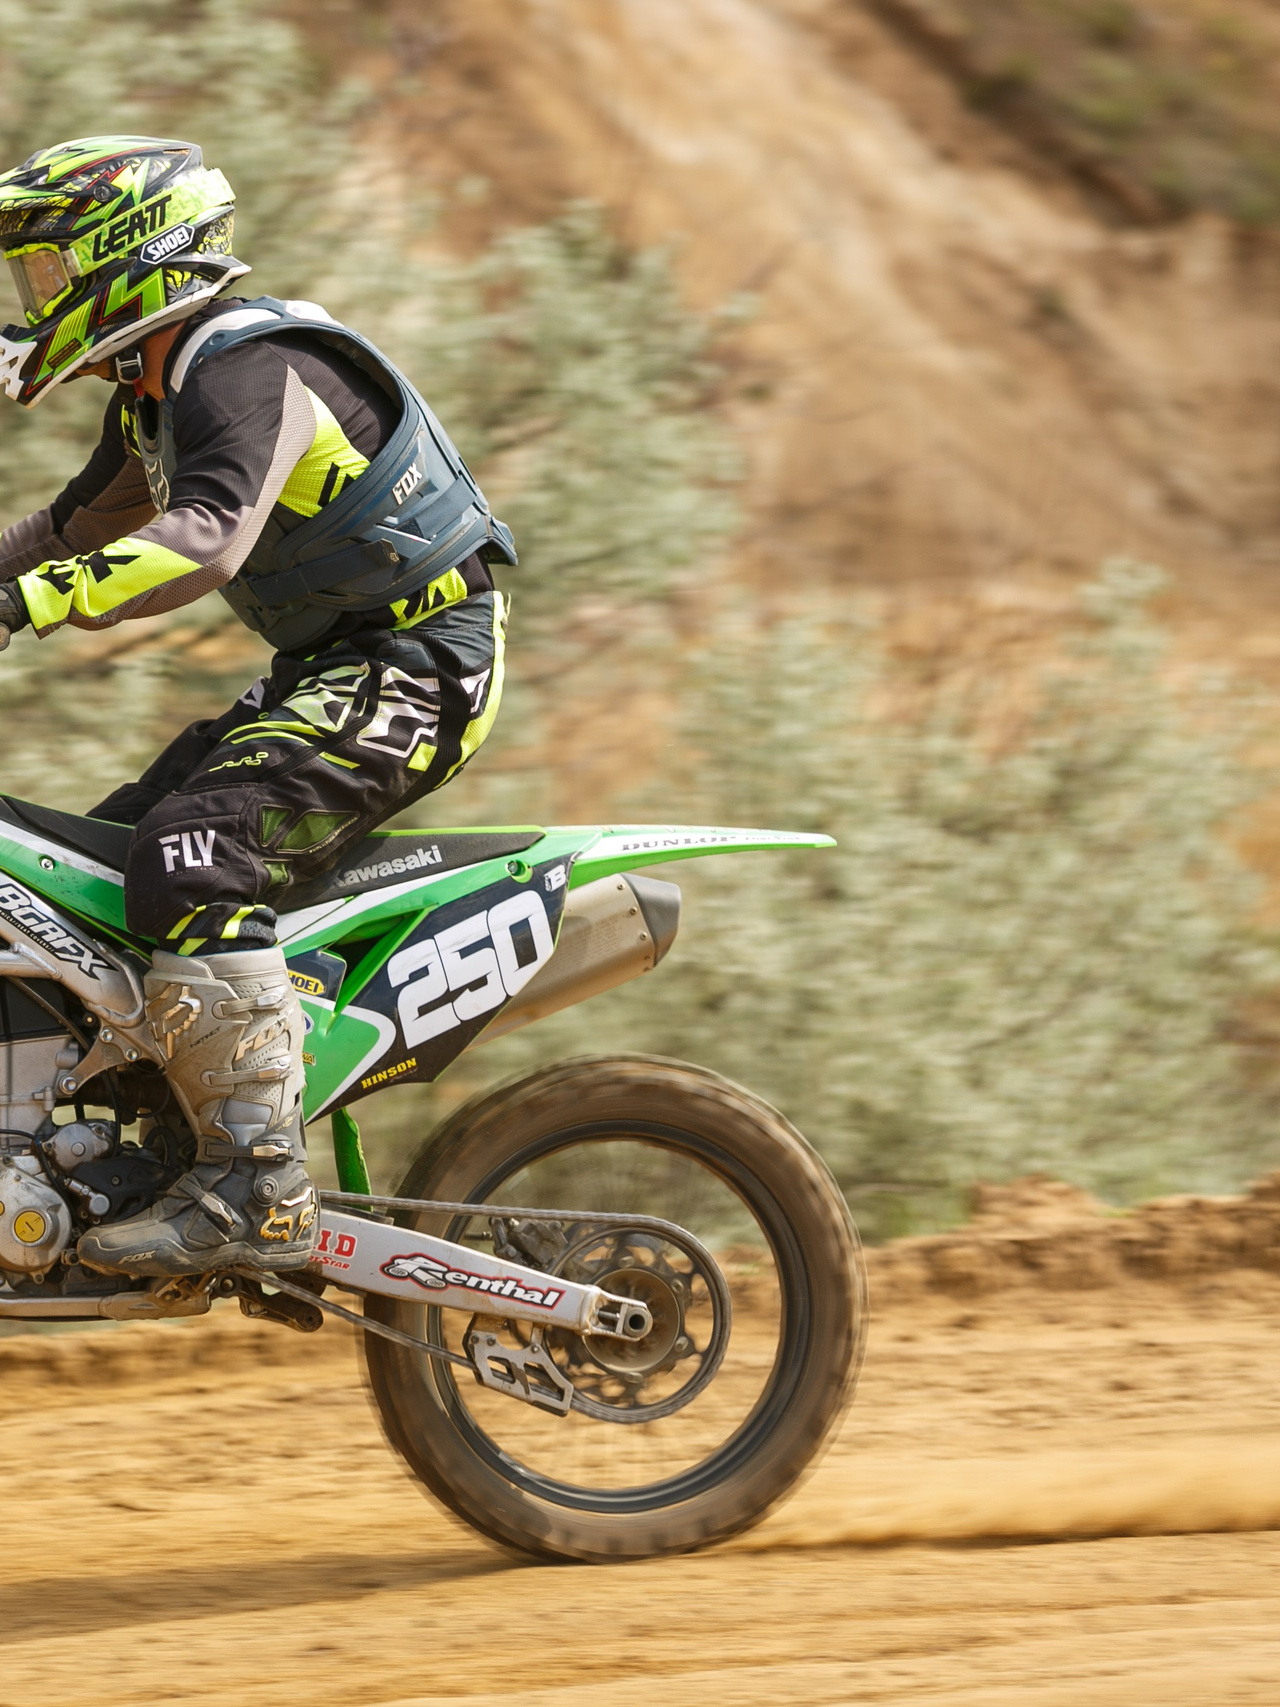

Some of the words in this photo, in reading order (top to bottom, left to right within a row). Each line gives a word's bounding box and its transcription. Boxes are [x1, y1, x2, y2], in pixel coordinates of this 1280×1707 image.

[93, 194, 172, 261] LEATT
[147, 226, 190, 260] SHOEI
[392, 462, 423, 505] FOX
[158, 829, 216, 873] FLY
[288, 972, 320, 993] HOEI
[387, 889, 554, 1050] 250
[361, 1057, 417, 1089] HINSON
[118, 1250, 156, 1265] FOX
[313, 1230, 356, 1257] .I.D
[384, 1255, 560, 1308] Renthal
